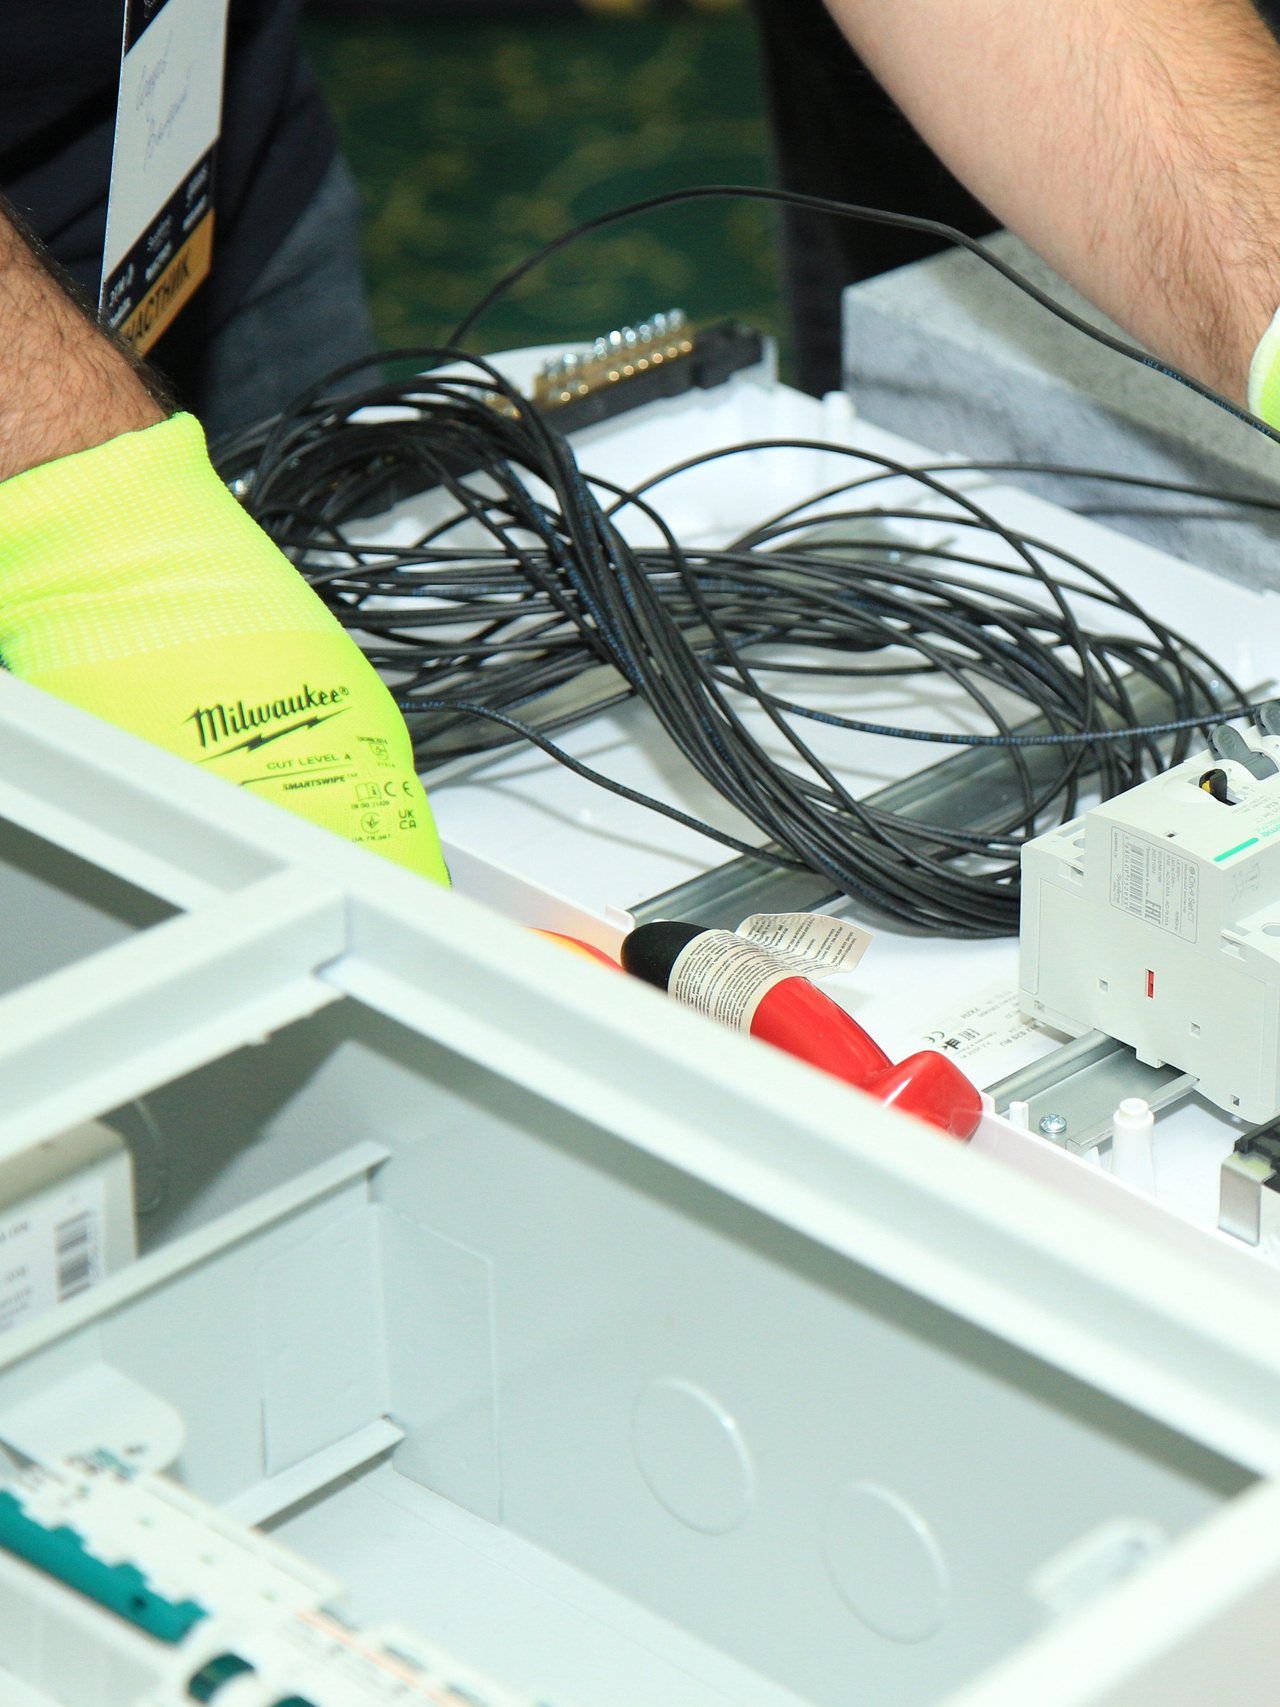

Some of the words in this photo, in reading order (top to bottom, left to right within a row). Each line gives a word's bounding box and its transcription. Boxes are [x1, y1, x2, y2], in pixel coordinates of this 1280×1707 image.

[266, 761, 293, 770] CUT
[299, 754, 338, 766] LEVEL
[1144, 898, 1160, 924] EAC
